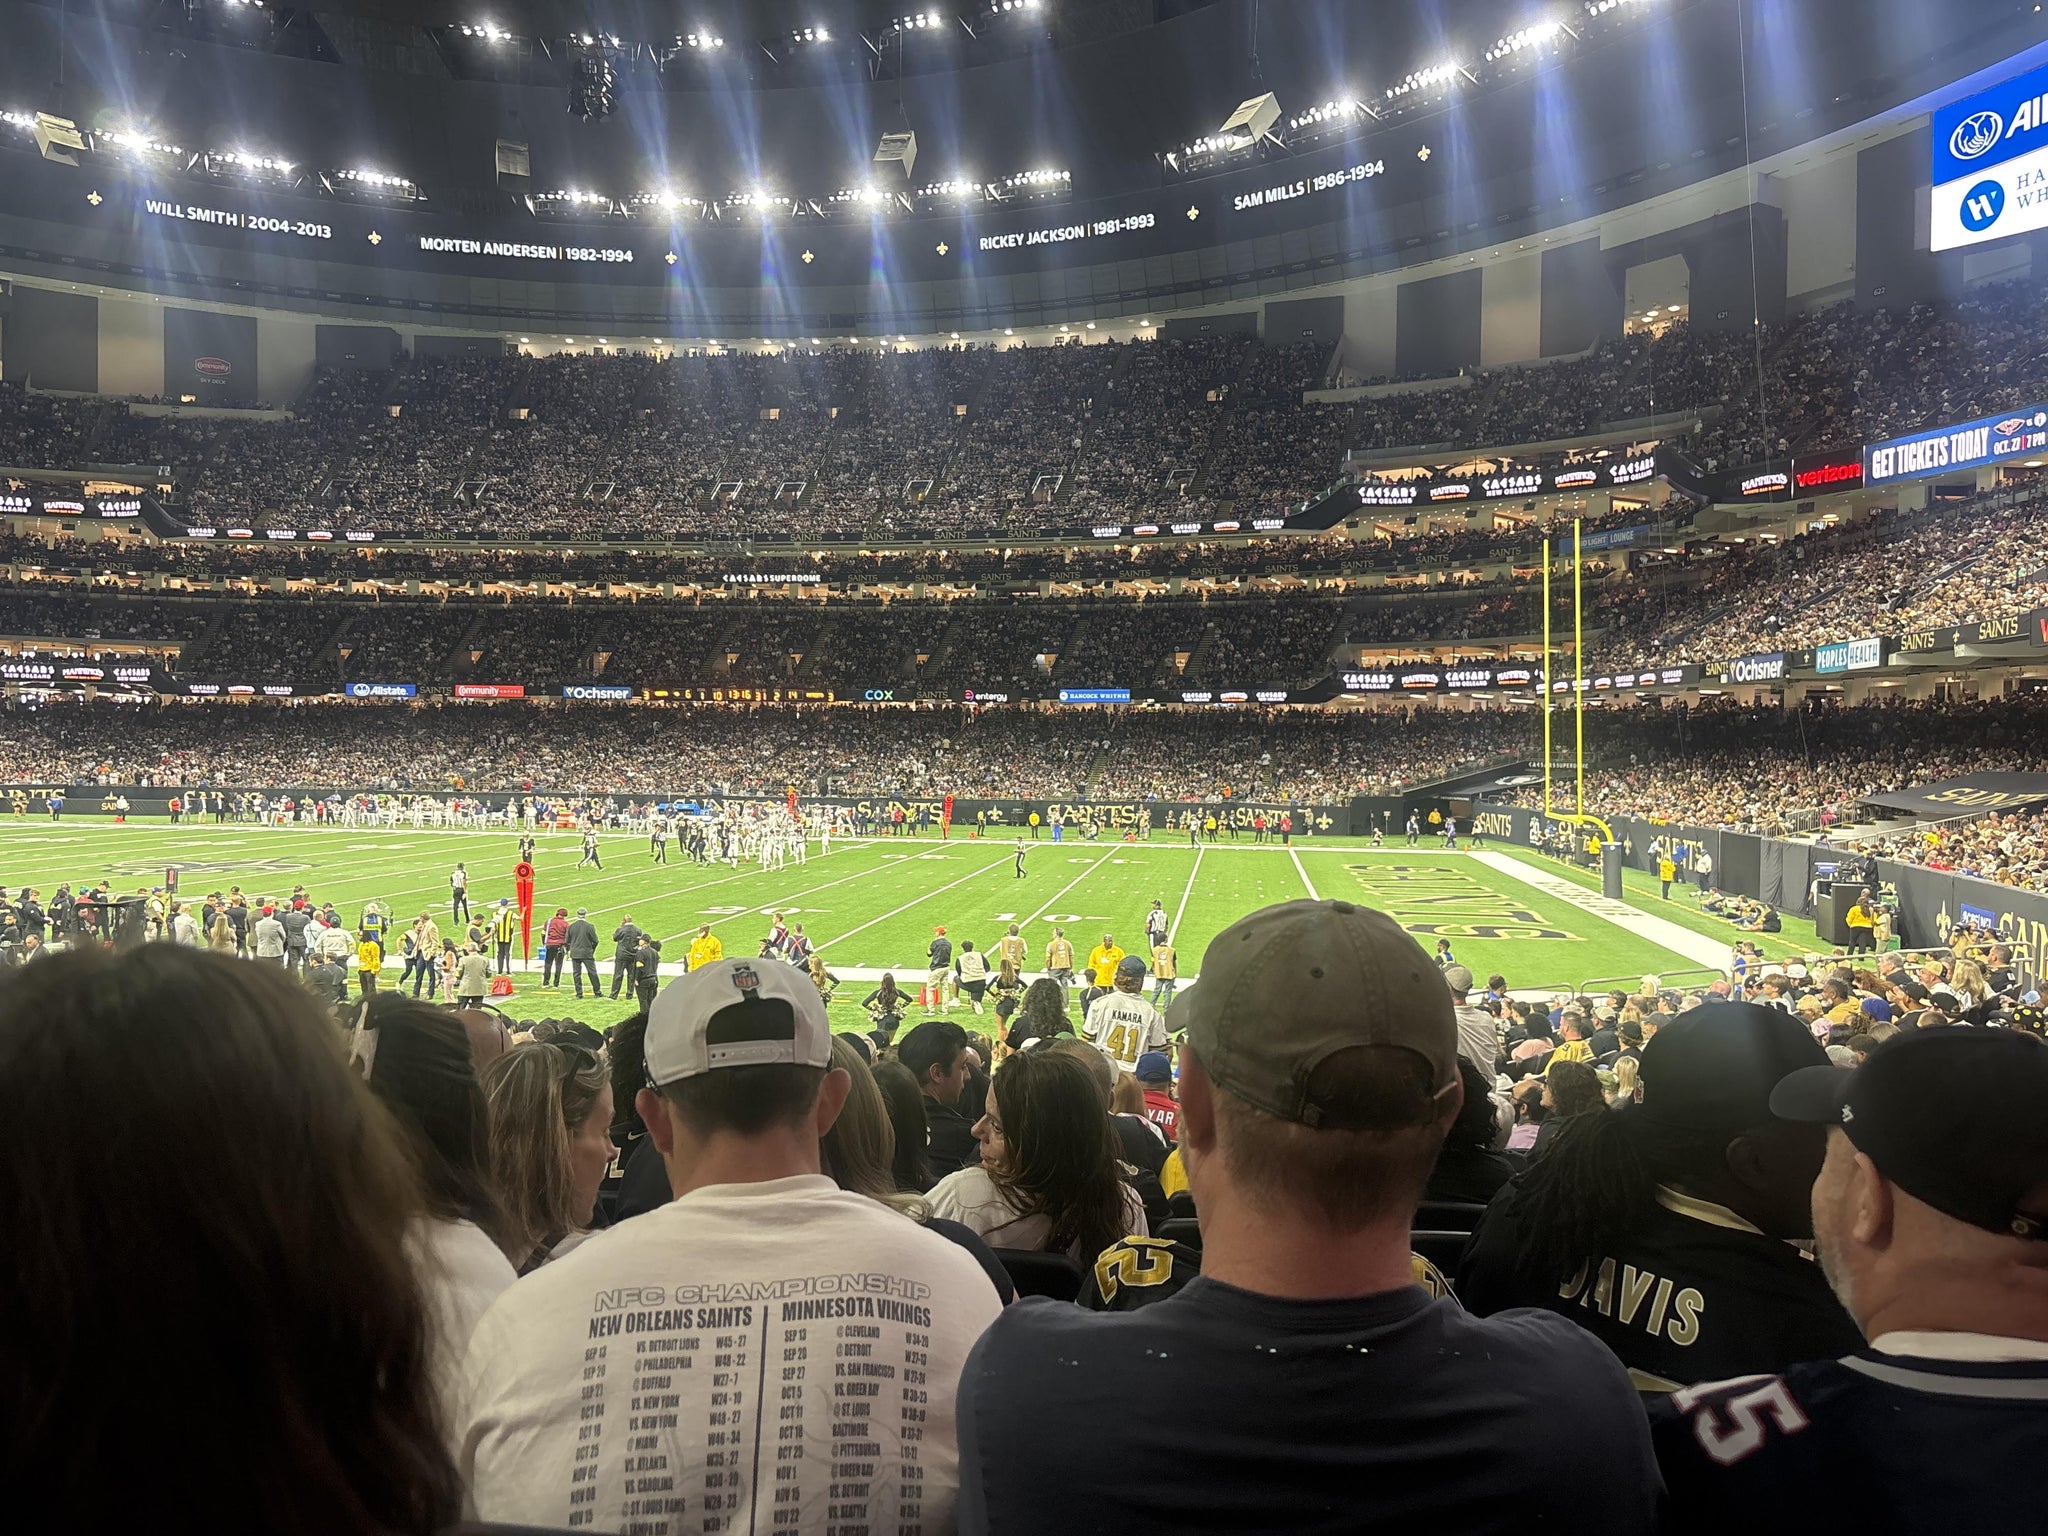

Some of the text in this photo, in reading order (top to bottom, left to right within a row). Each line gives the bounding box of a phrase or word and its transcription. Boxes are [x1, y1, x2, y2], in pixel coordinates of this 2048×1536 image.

[1234, 159, 1385, 210] SAM MILLS 1986-1994
[146, 199, 332, 239] WILL SMITH 2004-2013
[979, 213, 1156, 251] RICKEY JACKSON 1981-1993
[420, 237, 634, 263] MORTEN ANDERSEN 1982-1994
[1993, 442, 2011, 456] OCT.
[2033, 432, 2046, 447] PM
[1872, 427, 1989, 480] GET TICKETS TODAY
[1609, 457, 1655, 477] CAESARS
[1613, 469, 1653, 484] NEW ORLEANS
[1796, 462, 1862, 488] verizon
[1482, 473, 1543, 491] CAESARS
[1358, 486, 1418, 498] CAESARS
[1485, 485, 1538, 497] NEW ORLEANS
[97, 500, 141, 511] CAESARS
[1361, 497, 1413, 505] NEW ORLEANS
[423, 532, 456, 540] SAINTS
[497, 532, 530, 540] SAINTS
[569, 533, 603, 541] SAINTS
[643, 533, 676, 541] SAINTS
[790, 533, 822, 541] SAINTS
[862, 533, 895, 541] SAINTS
[934, 531, 967, 539] SAINTS
[1007, 530, 1041, 538] SAINTS
[1610, 530, 1634, 544] LOUNGE
[1489, 546, 1521, 557] SAINTS
[12, 556, 49, 566] SAINTS
[1340, 559, 1374, 569] SAINTS
[1415, 553, 1449, 565] SAINTS
[96, 561, 134, 571] SAINTS
[1191, 567, 1224, 575] SAINTS
[1264, 564, 1299, 572] SAINTS
[252, 568, 286, 577] SAINTS
[324, 570, 356, 578] SAINTS
[723, 574, 821, 583] CAESARS SUPERDOME
[848, 574, 878, 582] SAINTS
[915, 574, 945, 582] SAINTS
[981, 573, 1012, 581] SAINTS
[1049, 571, 1081, 580] SAINTS
[1119, 569, 1151, 578] SAINTS
[1979, 617, 2019, 640] SAINTS
[1901, 631, 1935, 651] SAINTS
[1816, 643, 1878, 670] PEOPLES HEALTH
[0, 663, 55, 674] CAESARS
[113, 667, 151, 677] CAESARS
[1735, 659, 1783, 682] Ochsner
[1342, 674, 1395, 684] CAESARS
[1445, 670, 1491, 681] CAESARS
[420, 686, 452, 694] SAINTS
[458, 685, 499, 696] Community
[573, 687, 629, 699] Ochsner
[712, 690, 723, 700] 10
[755, 690, 767, 700] 31
[865, 689, 894, 701] COX
[916, 690, 948, 699] SAINTS
[975, 692, 1008, 702] entergy
[1481, 812, 1512, 837] SAINTS
[492, 980, 508, 993] 20
[735, 975, 758, 988] NFL
[1111, 1008, 1143, 1025] KAMARA
[1106, 1025, 1140, 1063] 41
[594, 1273, 932, 1312] NFC CHAMPIONSHIP
[782, 1296, 932, 1328] MINNESOTA VIKINGS
[588, 1305, 753, 1339] NEW ORLEANS SAINTS
[783, 1325, 880, 1342] SEP 13 CLEVELAND
[649, 1334, 747, 1353] DETROIT LIONS W45 27
[783, 1343, 872, 1361] SEP 20 DETROIT
[643, 1353, 746, 1371] PHILADELPHIA W48 22
[782, 1362, 895, 1381] SEP 27 VS. SAN FRANCISCO
[641, 1373, 729, 1391] BUFFALO W27
[781, 1383, 867, 1400] OCT VS. GREEN
[643, 1393, 728, 1409] NEW YORK W24
[780, 1404, 803, 1420] OCT 11
[641, 1414, 679, 1430] NEW YORK
[779, 1423, 869, 1439] OCT BALTIMORE
[778, 1446, 792, 1460] OCT
[776, 1466, 791, 1480] NOV
